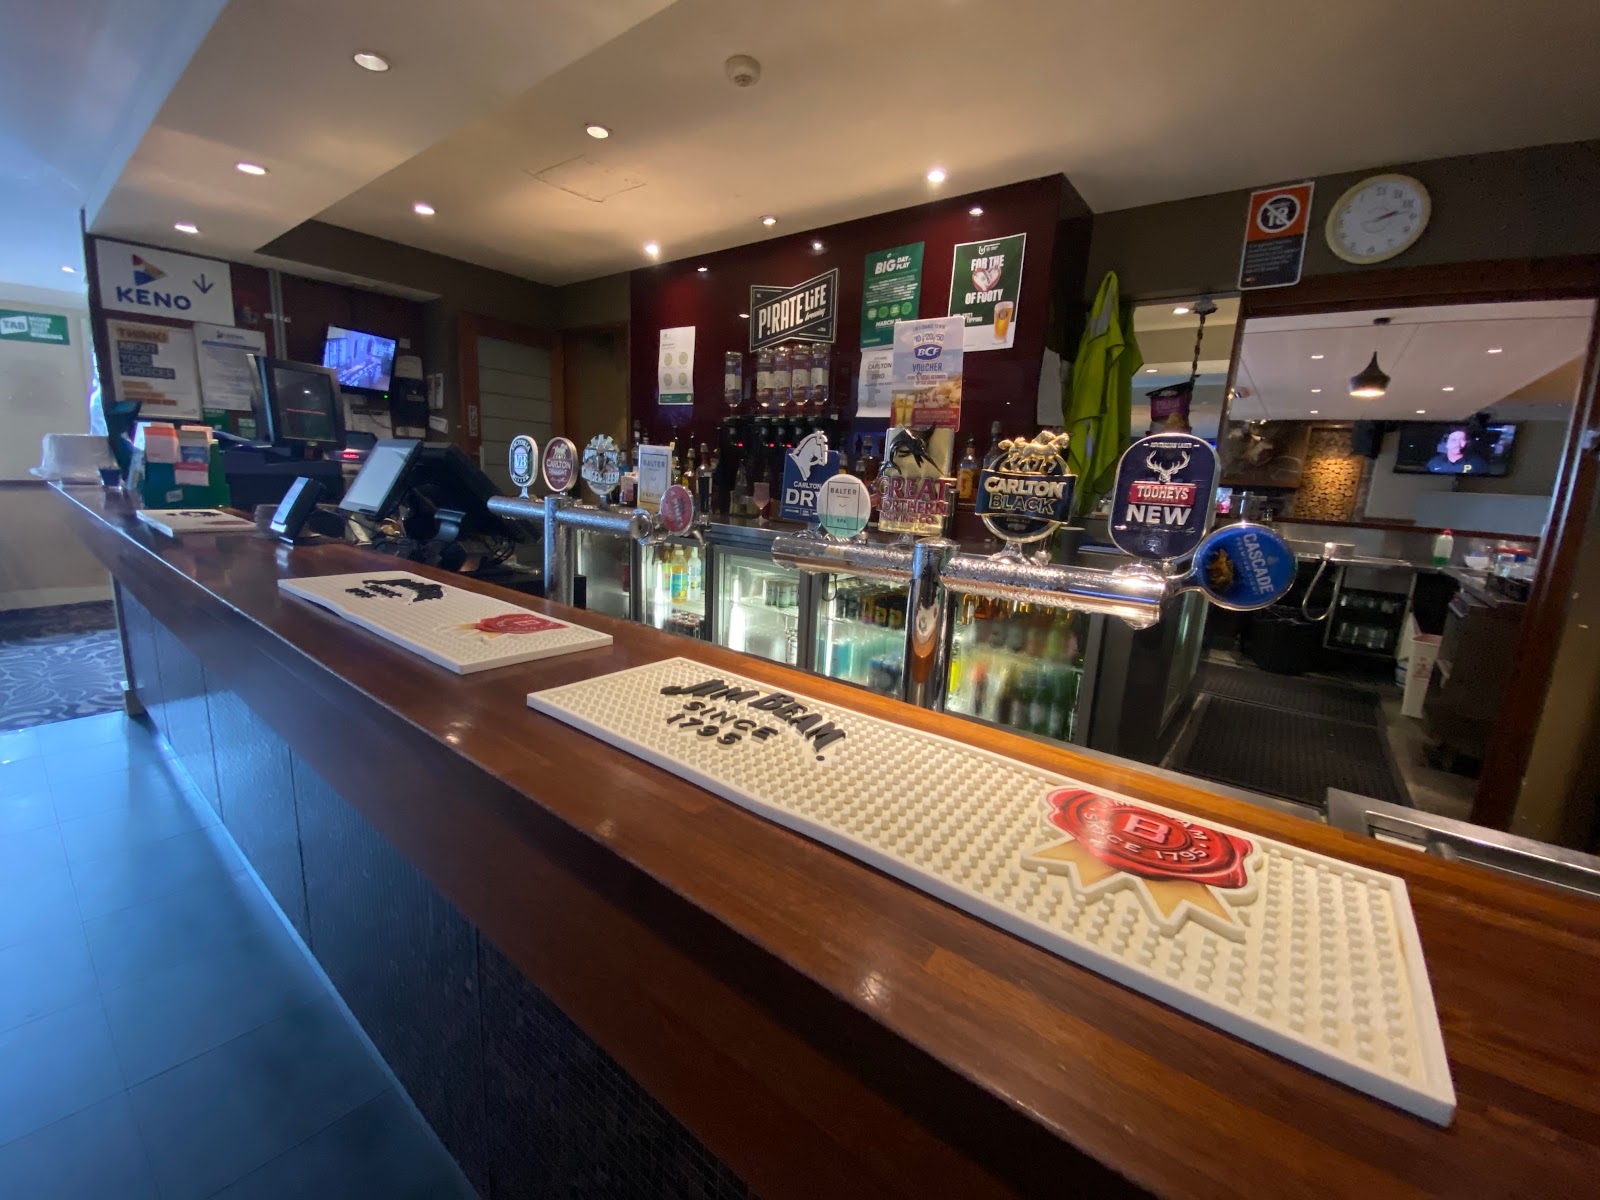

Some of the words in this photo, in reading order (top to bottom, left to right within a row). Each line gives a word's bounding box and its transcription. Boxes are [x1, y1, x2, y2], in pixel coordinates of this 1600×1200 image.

[875, 259, 896, 275] BIG
[896, 261, 910, 271] PLAY
[897, 256, 909, 264] DAY
[970, 257, 987, 271] FOR
[988, 254, 1005, 269] THE
[116, 286, 191, 310] KENO
[964, 292, 976, 305] OF
[976, 289, 1004, 304] FOOTY
[3, 320, 25, 330] TAB
[875, 318, 894, 327] MARCH
[917, 346, 940, 357] BCF
[867, 362, 892, 370] CARLTON
[912, 362, 943, 372] VOUCHER
[514, 453, 528, 469] VB
[546, 459, 571, 470] CARLTON
[643, 459, 666, 468] BALTER
[830, 487, 857, 495] BALTER
[877, 475, 955, 501] GREAT
[984, 476, 1068, 498] CARLTON
[1136, 485, 1189, 499] TOOHEYS
[988, 492, 1057, 515] BLACK
[1126, 504, 1192, 526] NEW
[1243, 533, 1274, 595] CASCADE
[660, 679, 760, 704] JIM
[748, 692, 847, 753] BEAM
[682, 701, 779, 742] SINCE
[667, 713, 742, 746] 1795
[1122, 813, 1169, 844] B
[1155, 847, 1207, 861] 1795
